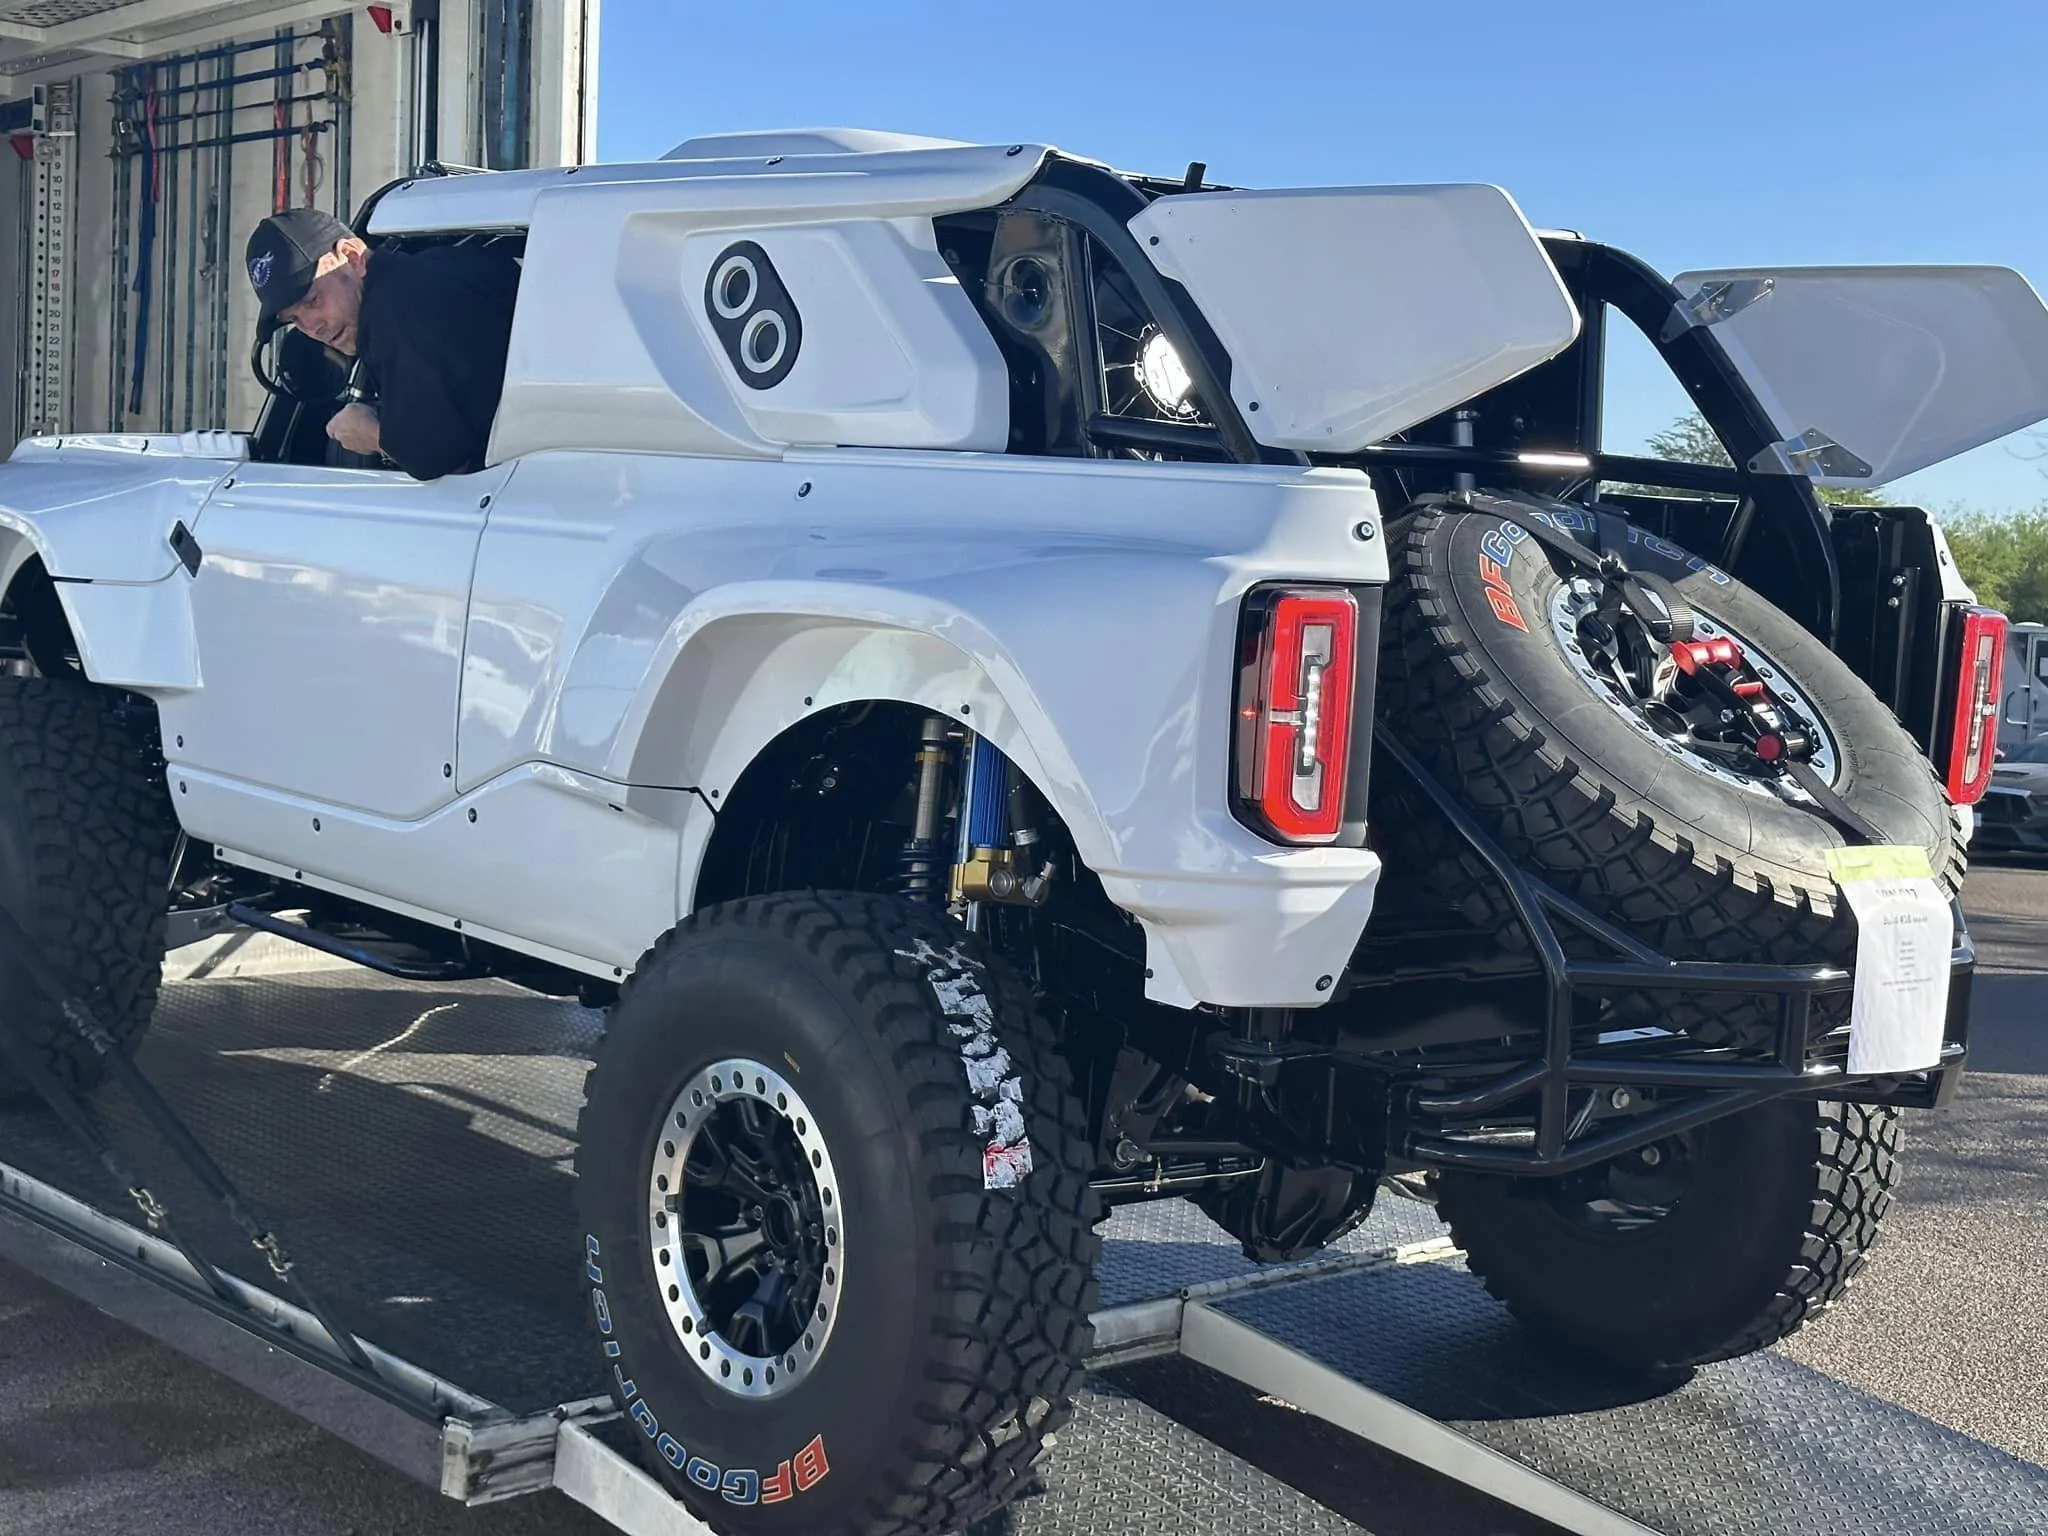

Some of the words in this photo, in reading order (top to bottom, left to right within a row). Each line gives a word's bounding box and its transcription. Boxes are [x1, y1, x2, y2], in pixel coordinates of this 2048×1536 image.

[55, 162, 61, 170] 9
[53, 202, 61, 210] 12
[51, 243, 61, 251] 15
[52, 270, 60, 278] 17
[51, 283, 60, 291] 18
[49, 337, 60, 345] 22
[48, 363, 59, 371] 24
[47, 403, 58, 412] 27
